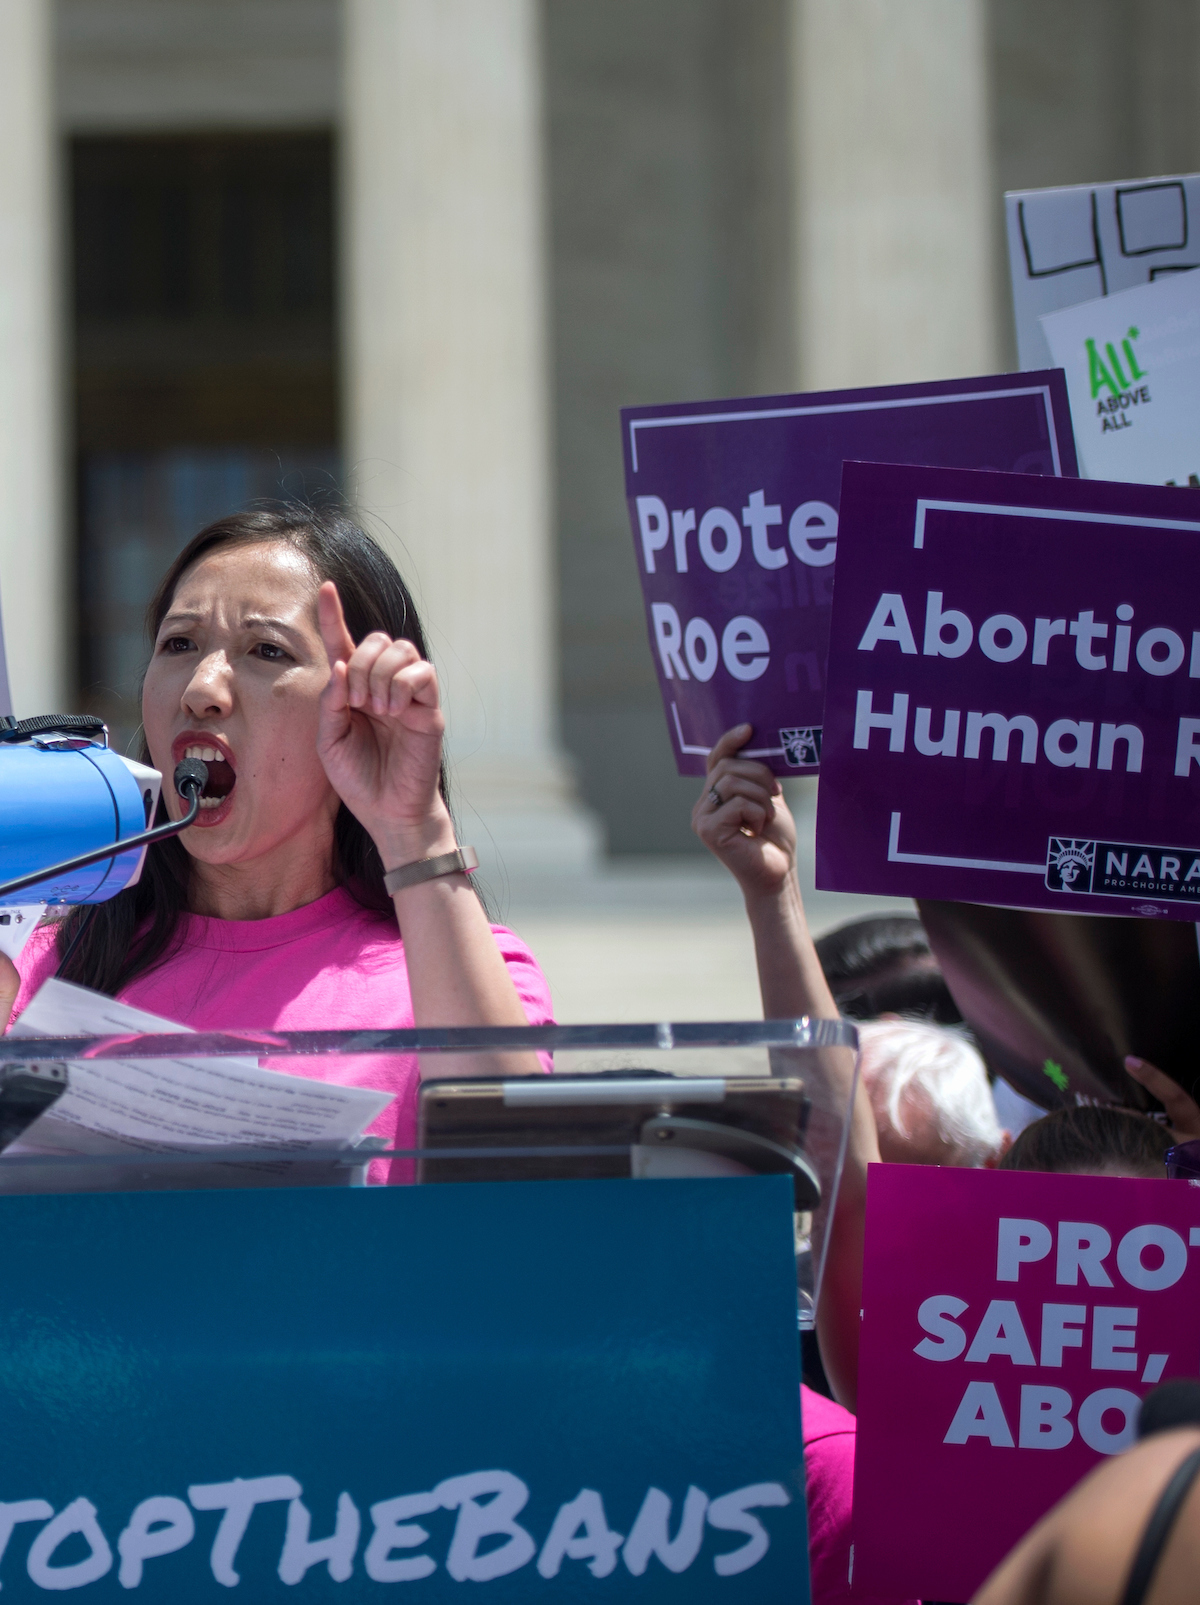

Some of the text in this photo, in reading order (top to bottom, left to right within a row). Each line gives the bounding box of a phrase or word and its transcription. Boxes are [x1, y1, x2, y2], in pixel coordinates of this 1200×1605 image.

[1097, 385, 1151, 416] ABOVE
[1102, 411, 1132, 434] ALL
[636, 489, 839, 574] Prote
[651, 601, 771, 683] Roe
[857, 590, 1200, 679] Abortio
[852, 690, 1144, 774] Human
[1104, 878, 1175, 891] PRO-CHOICE
[996, 1217, 1200, 1292] PRO
[913, 1295, 1170, 1384] SAFE,
[943, 1380, 1145, 1456] ABO
